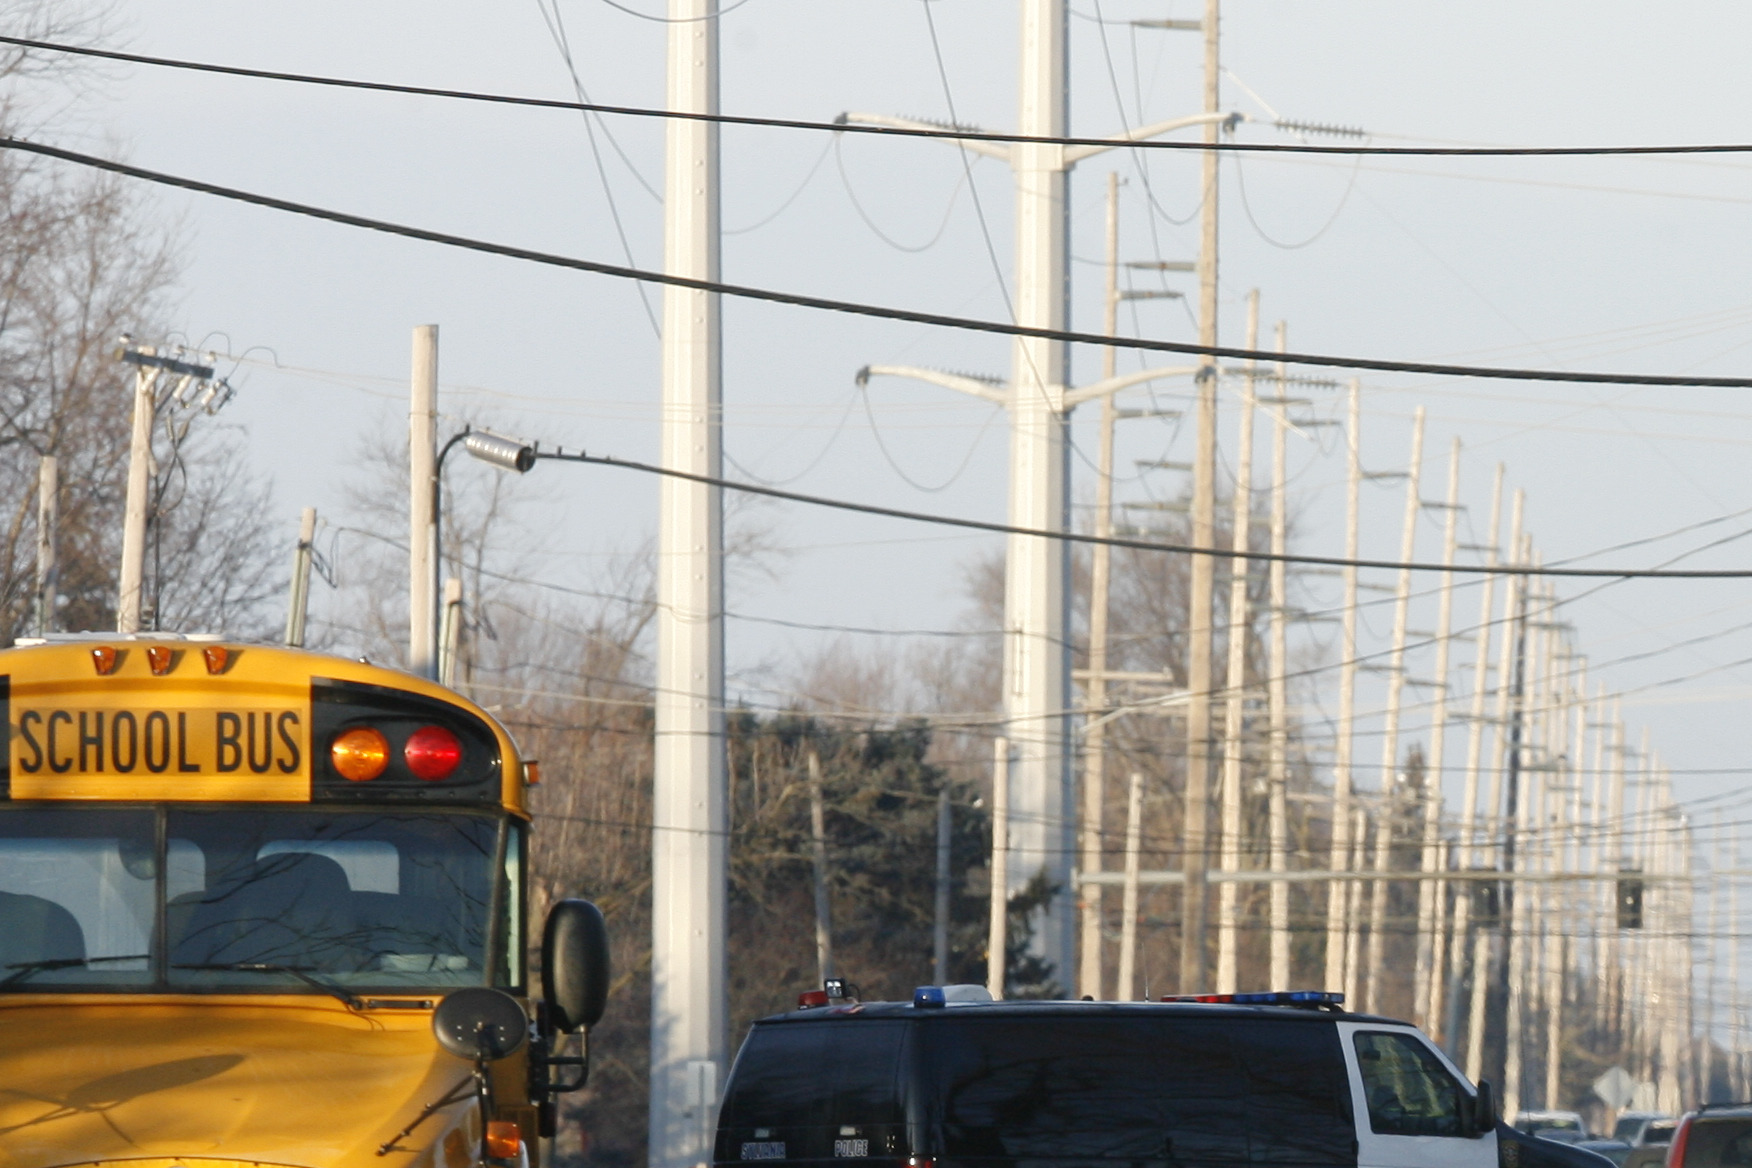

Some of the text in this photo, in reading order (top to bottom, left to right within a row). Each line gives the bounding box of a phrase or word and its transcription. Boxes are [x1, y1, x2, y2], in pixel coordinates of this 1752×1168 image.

[19, 710, 301, 774] SCHOOL BUS
[834, 1139, 869, 1158] POLICE
